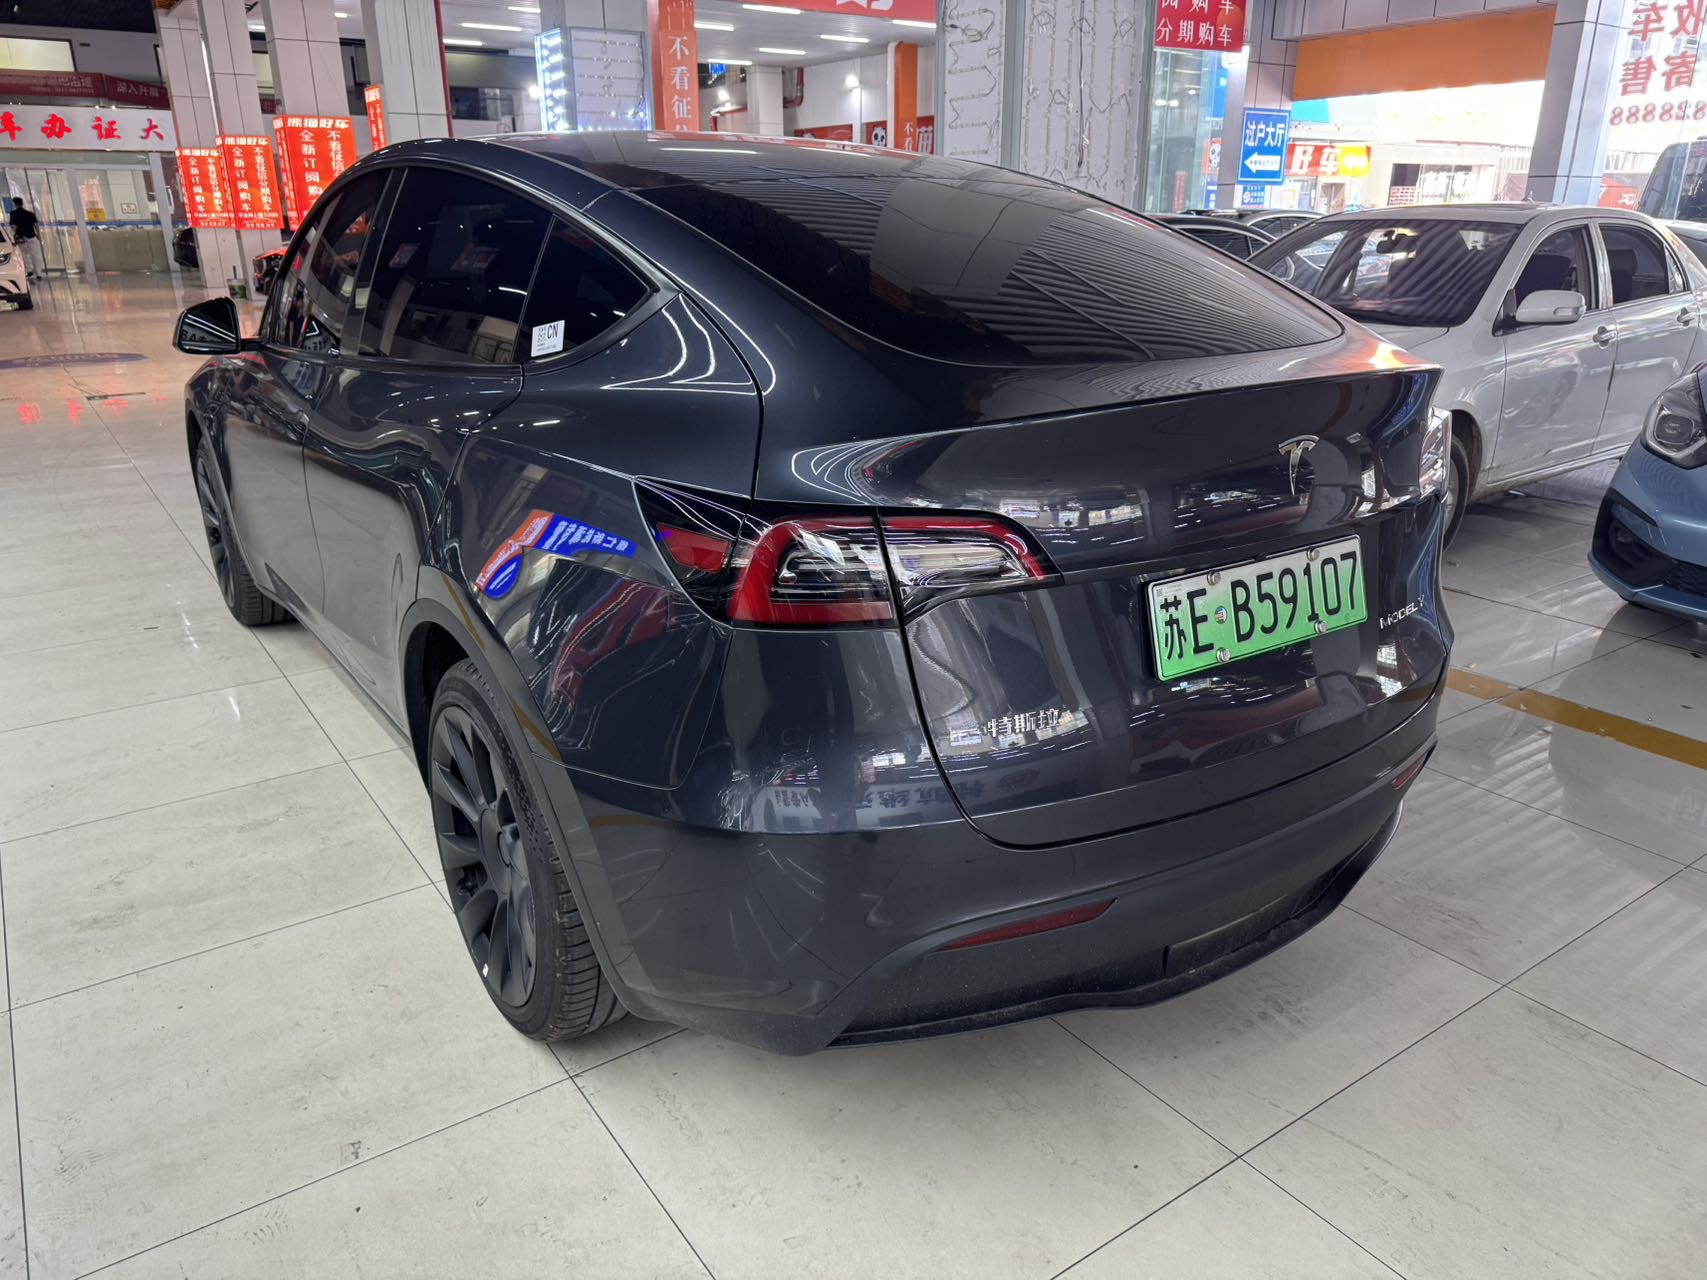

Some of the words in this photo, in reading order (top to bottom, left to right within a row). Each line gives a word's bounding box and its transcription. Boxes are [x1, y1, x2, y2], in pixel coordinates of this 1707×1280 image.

[1155, 17, 1233, 47] 分期购车
[667, 35, 693, 132] 不看征
[287, 117, 349, 129] 熊猫好车
[1244, 120, 1285, 147] 过户大厅
[299, 129, 325, 205] 全新订阅购
[547, 322, 559, 340] CN
[1160, 588, 1215, 661] 苏E
[1230, 550, 1358, 644] B59107
[1380, 604, 1421, 631] MODEL
[986, 707, 1060, 739] 特斯拉
